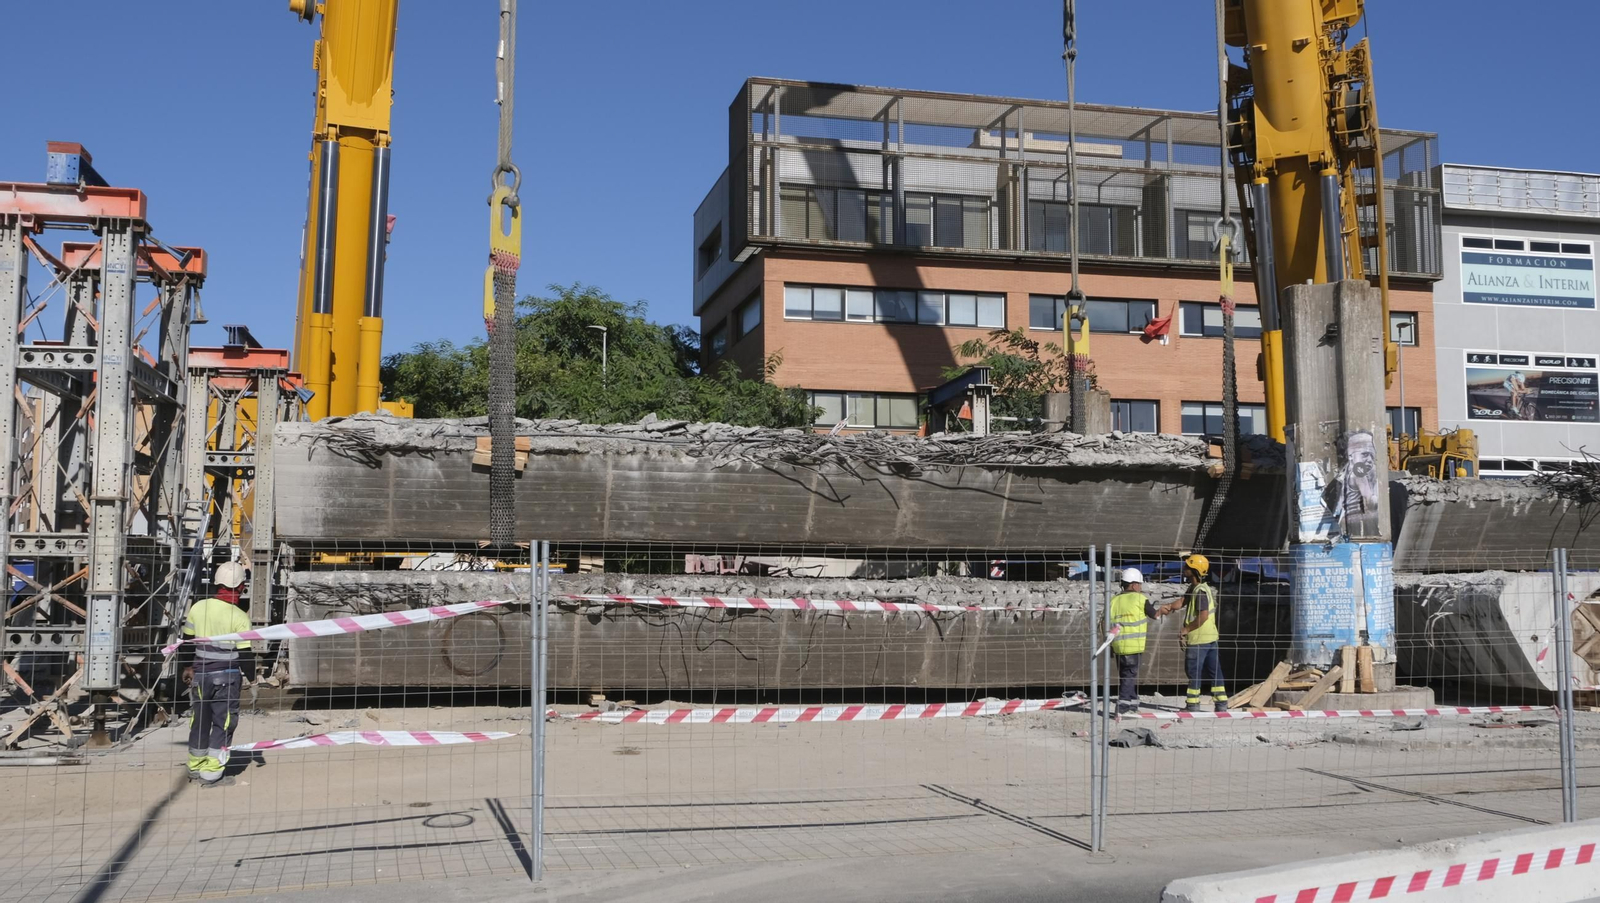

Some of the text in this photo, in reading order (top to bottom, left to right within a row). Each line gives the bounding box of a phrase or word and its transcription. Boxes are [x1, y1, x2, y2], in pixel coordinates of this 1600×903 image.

[1489, 256, 1566, 267] FORMACIÓN
[1467, 272, 1590, 291] ALIANZA & INTERIM
[1481, 296, 1578, 306] WWW.ALIANZAINTERIM.COM
[1549, 376, 1591, 385] PRECISIONFIT
